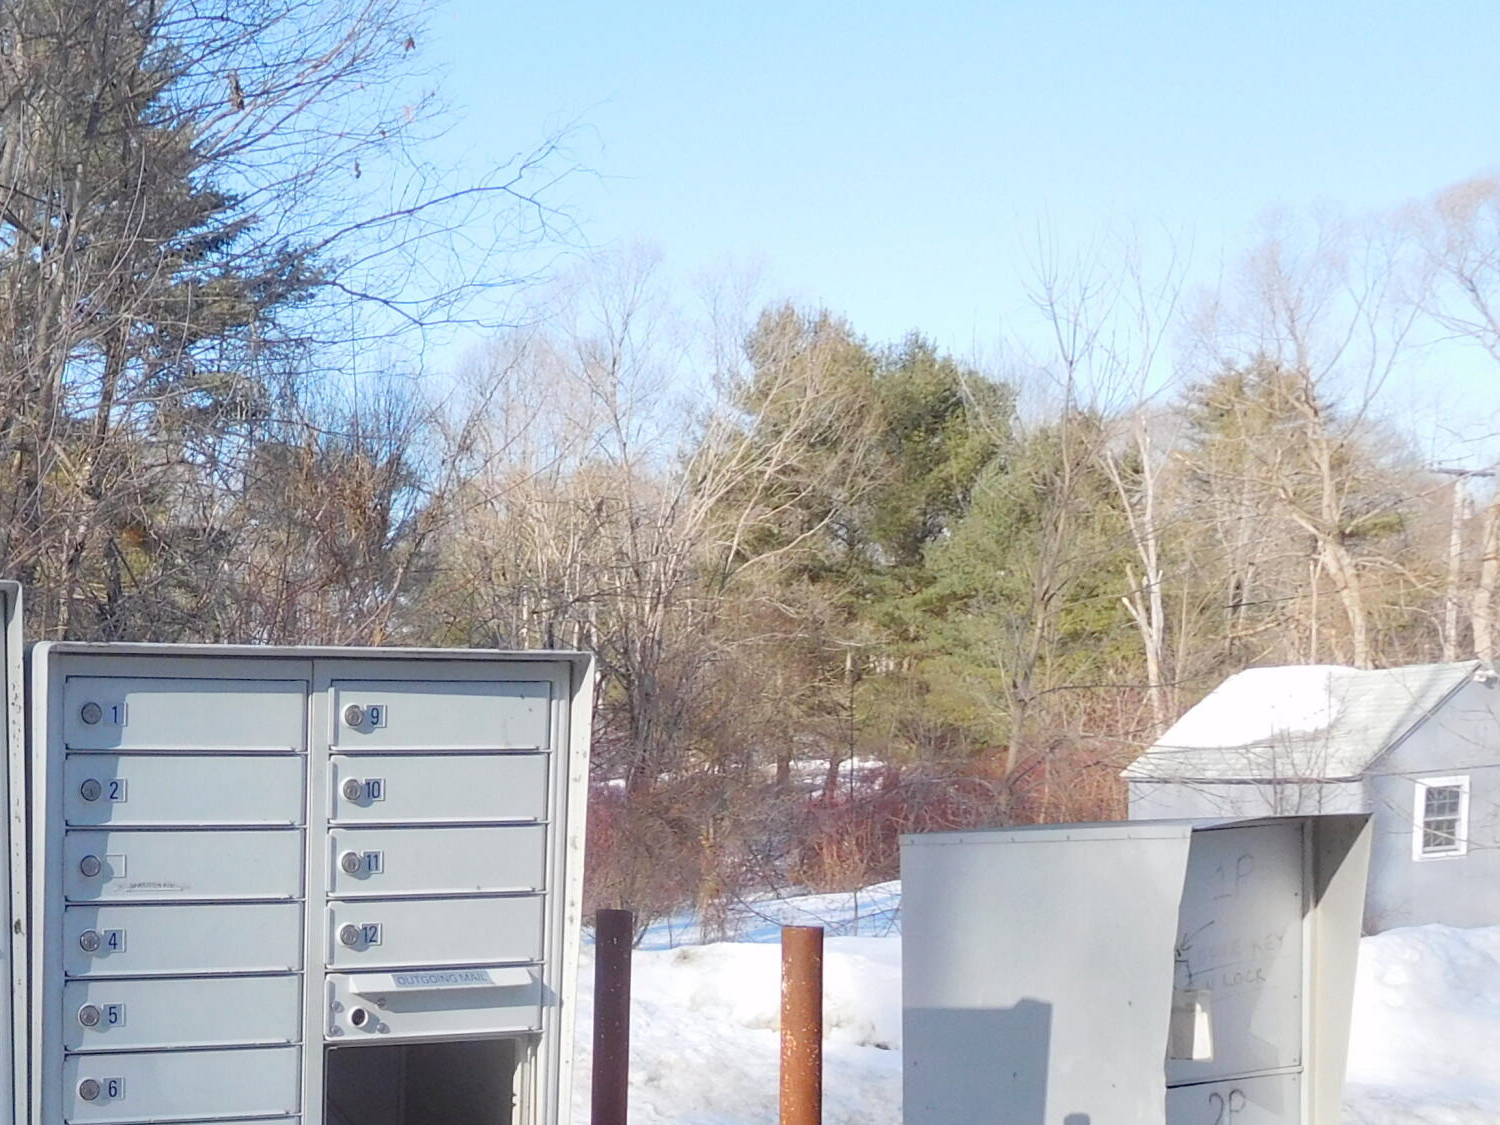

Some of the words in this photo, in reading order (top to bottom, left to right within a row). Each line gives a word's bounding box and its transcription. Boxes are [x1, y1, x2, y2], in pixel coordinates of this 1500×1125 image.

[112, 706, 118, 723] 1
[370, 707, 380, 725] 9
[109, 781, 119, 799] 2
[365, 781, 381, 798] 10
[365, 854, 380, 871] 11
[108, 932, 118, 950] 4
[362, 925, 379, 943] 12
[396, 973, 457, 986] OUTGOING
[459, 971, 488, 982] MAIL
[1222, 967, 1267, 987] LOCK
[108, 1006, 118, 1024] 5
[108, 1080, 118, 1098] 6
